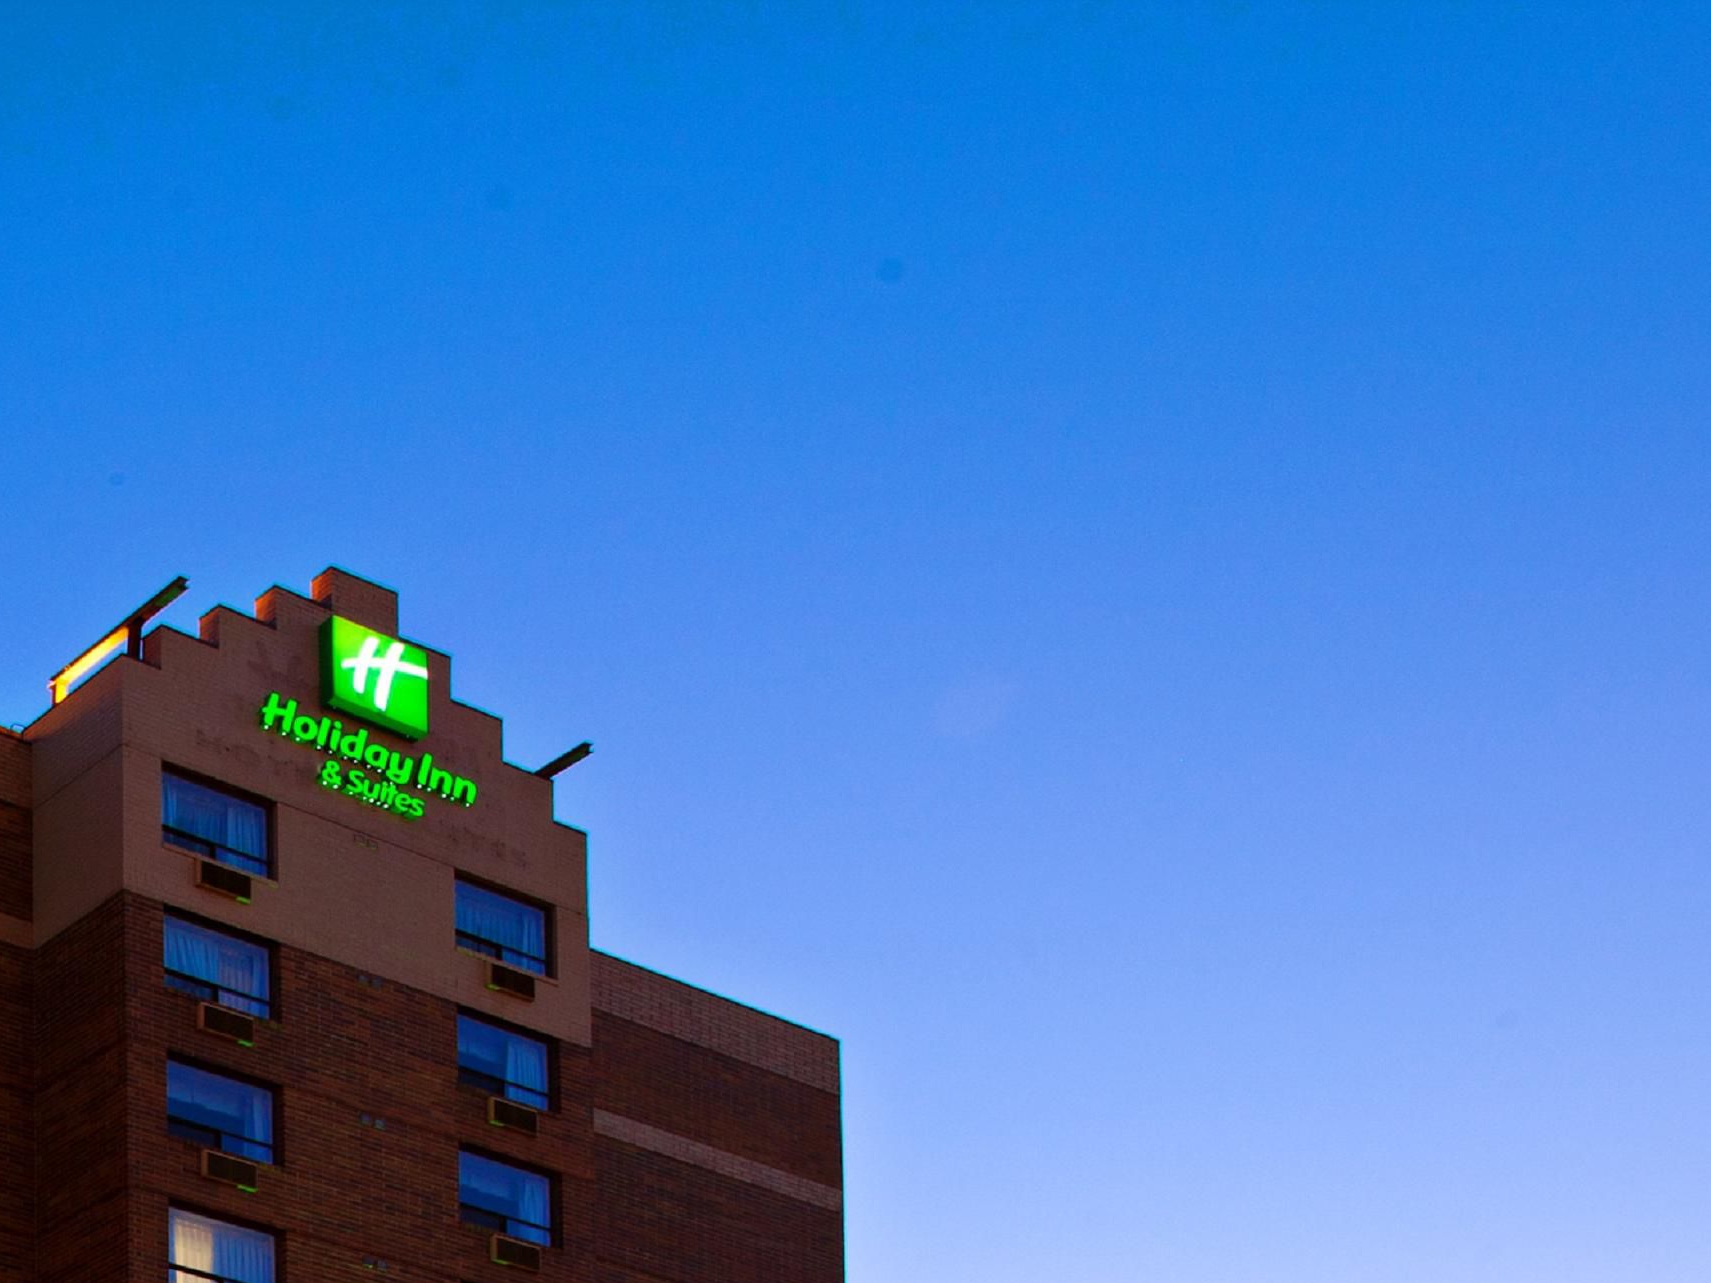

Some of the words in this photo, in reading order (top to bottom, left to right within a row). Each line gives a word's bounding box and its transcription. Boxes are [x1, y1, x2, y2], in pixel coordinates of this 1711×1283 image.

[261, 692, 413, 785] Holiday
[417, 753, 477, 805] Inn
[321, 760, 341, 785] &
[346, 769, 425, 817] Suites
